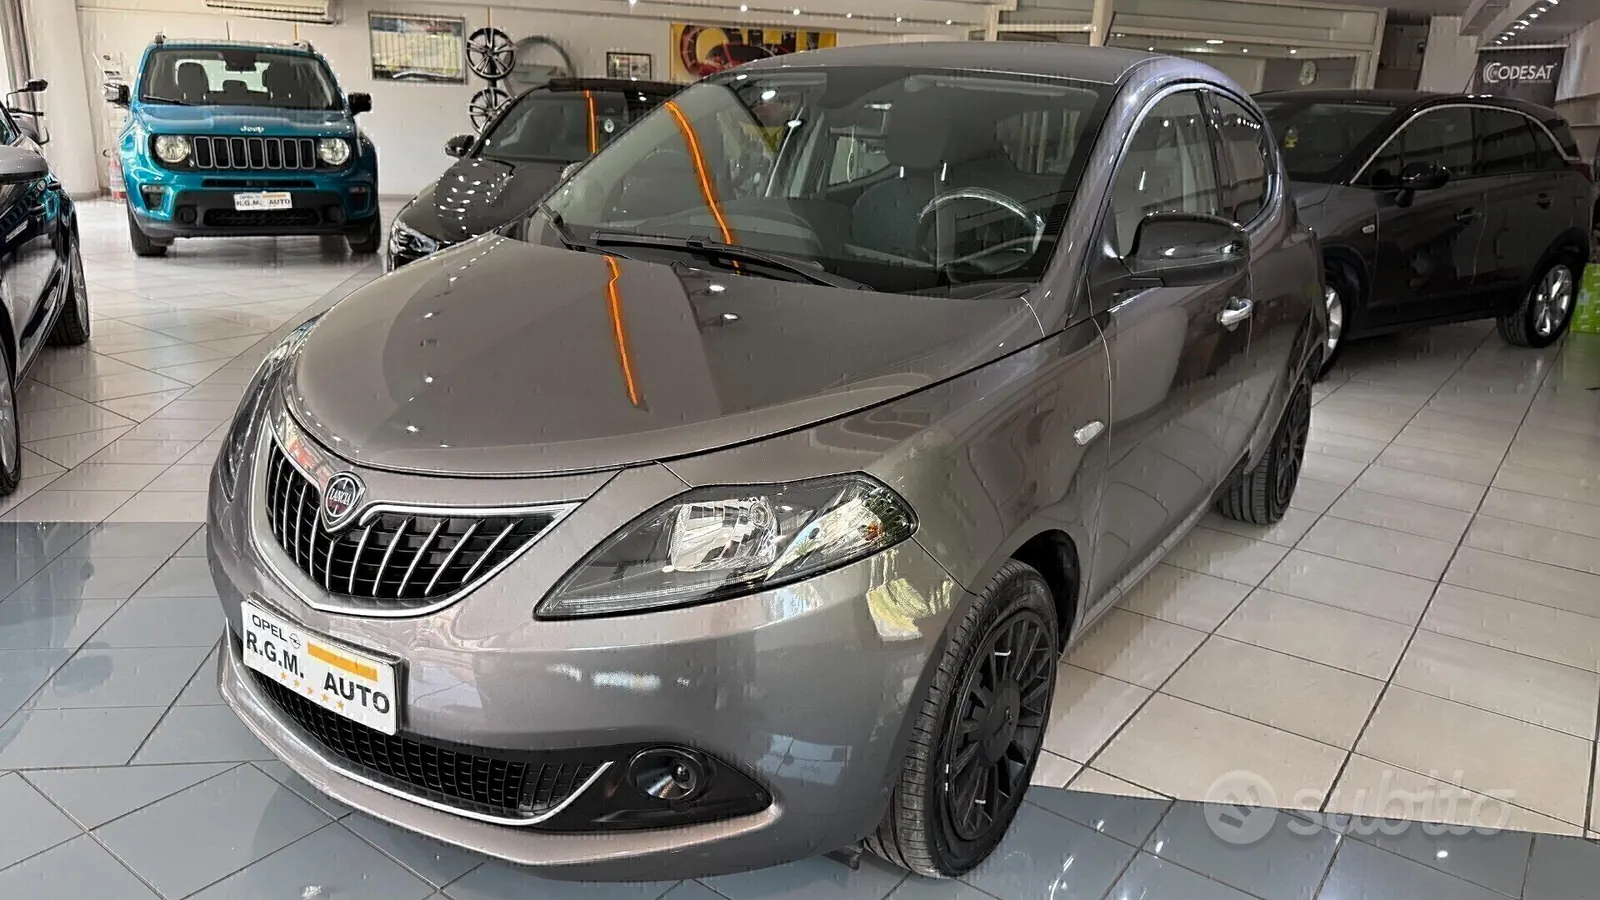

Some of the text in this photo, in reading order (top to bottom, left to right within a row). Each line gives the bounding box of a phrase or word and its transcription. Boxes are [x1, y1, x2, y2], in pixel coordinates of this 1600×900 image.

[1483, 62, 1554, 83] CODESAT
[252, 614, 288, 642] OPEL
[246, 630, 390, 714] R.G.M. AUTO
